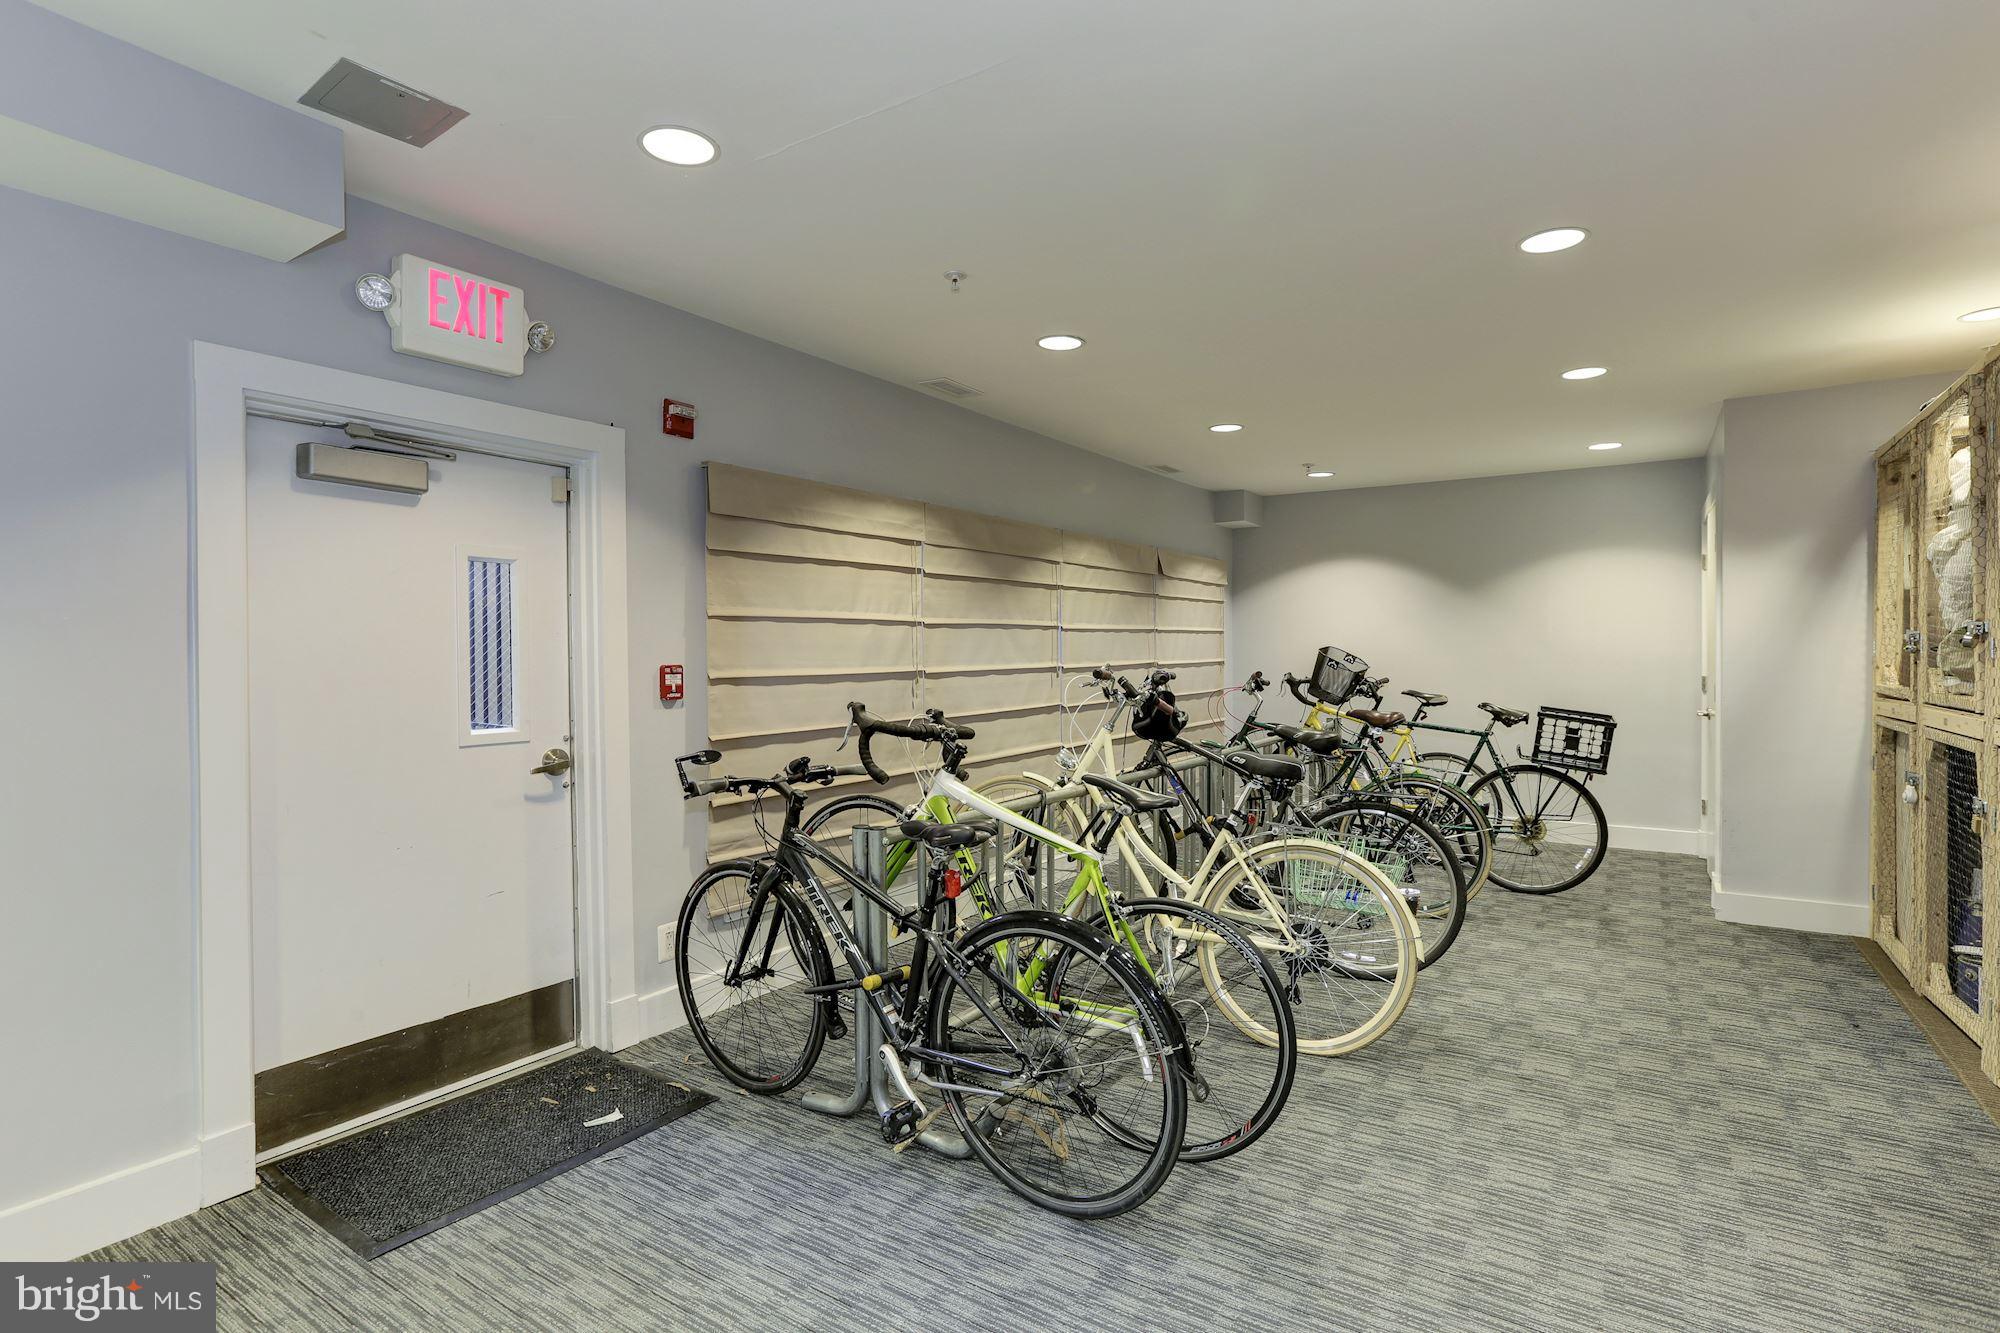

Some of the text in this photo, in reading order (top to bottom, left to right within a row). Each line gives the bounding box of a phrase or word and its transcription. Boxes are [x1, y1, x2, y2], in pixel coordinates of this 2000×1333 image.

[429, 268, 510, 343] EXIT
[805, 878, 857, 956] TREK
[957, 848, 995, 918] REK
